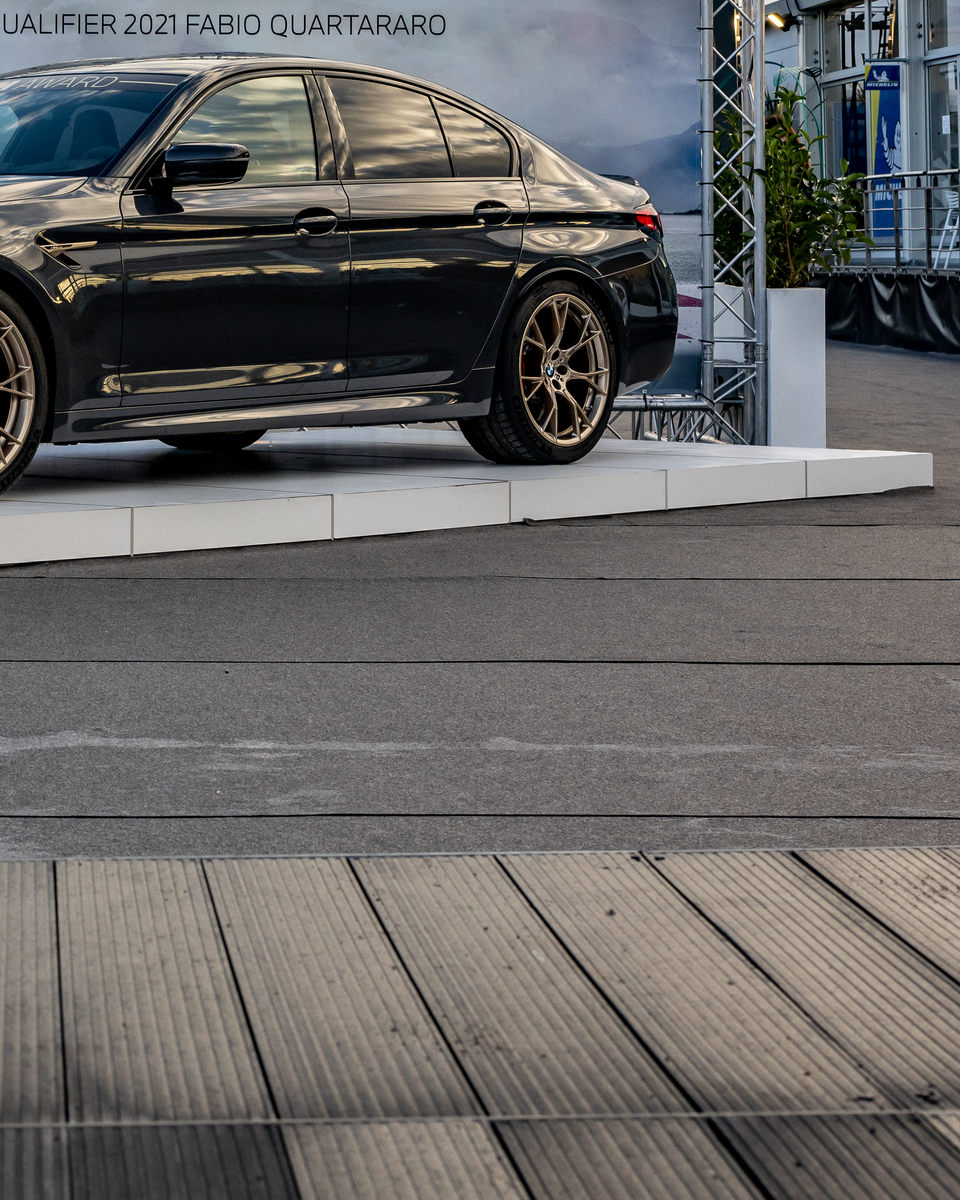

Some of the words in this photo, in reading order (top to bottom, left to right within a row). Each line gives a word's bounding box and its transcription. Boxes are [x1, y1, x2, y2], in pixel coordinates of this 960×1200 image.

[123, 13, 177, 35] 2021
[186, 14, 261, 35] FABIO
[270, 14, 447, 38] QUARTARARO
[14, 75, 118, 89] AWARD
